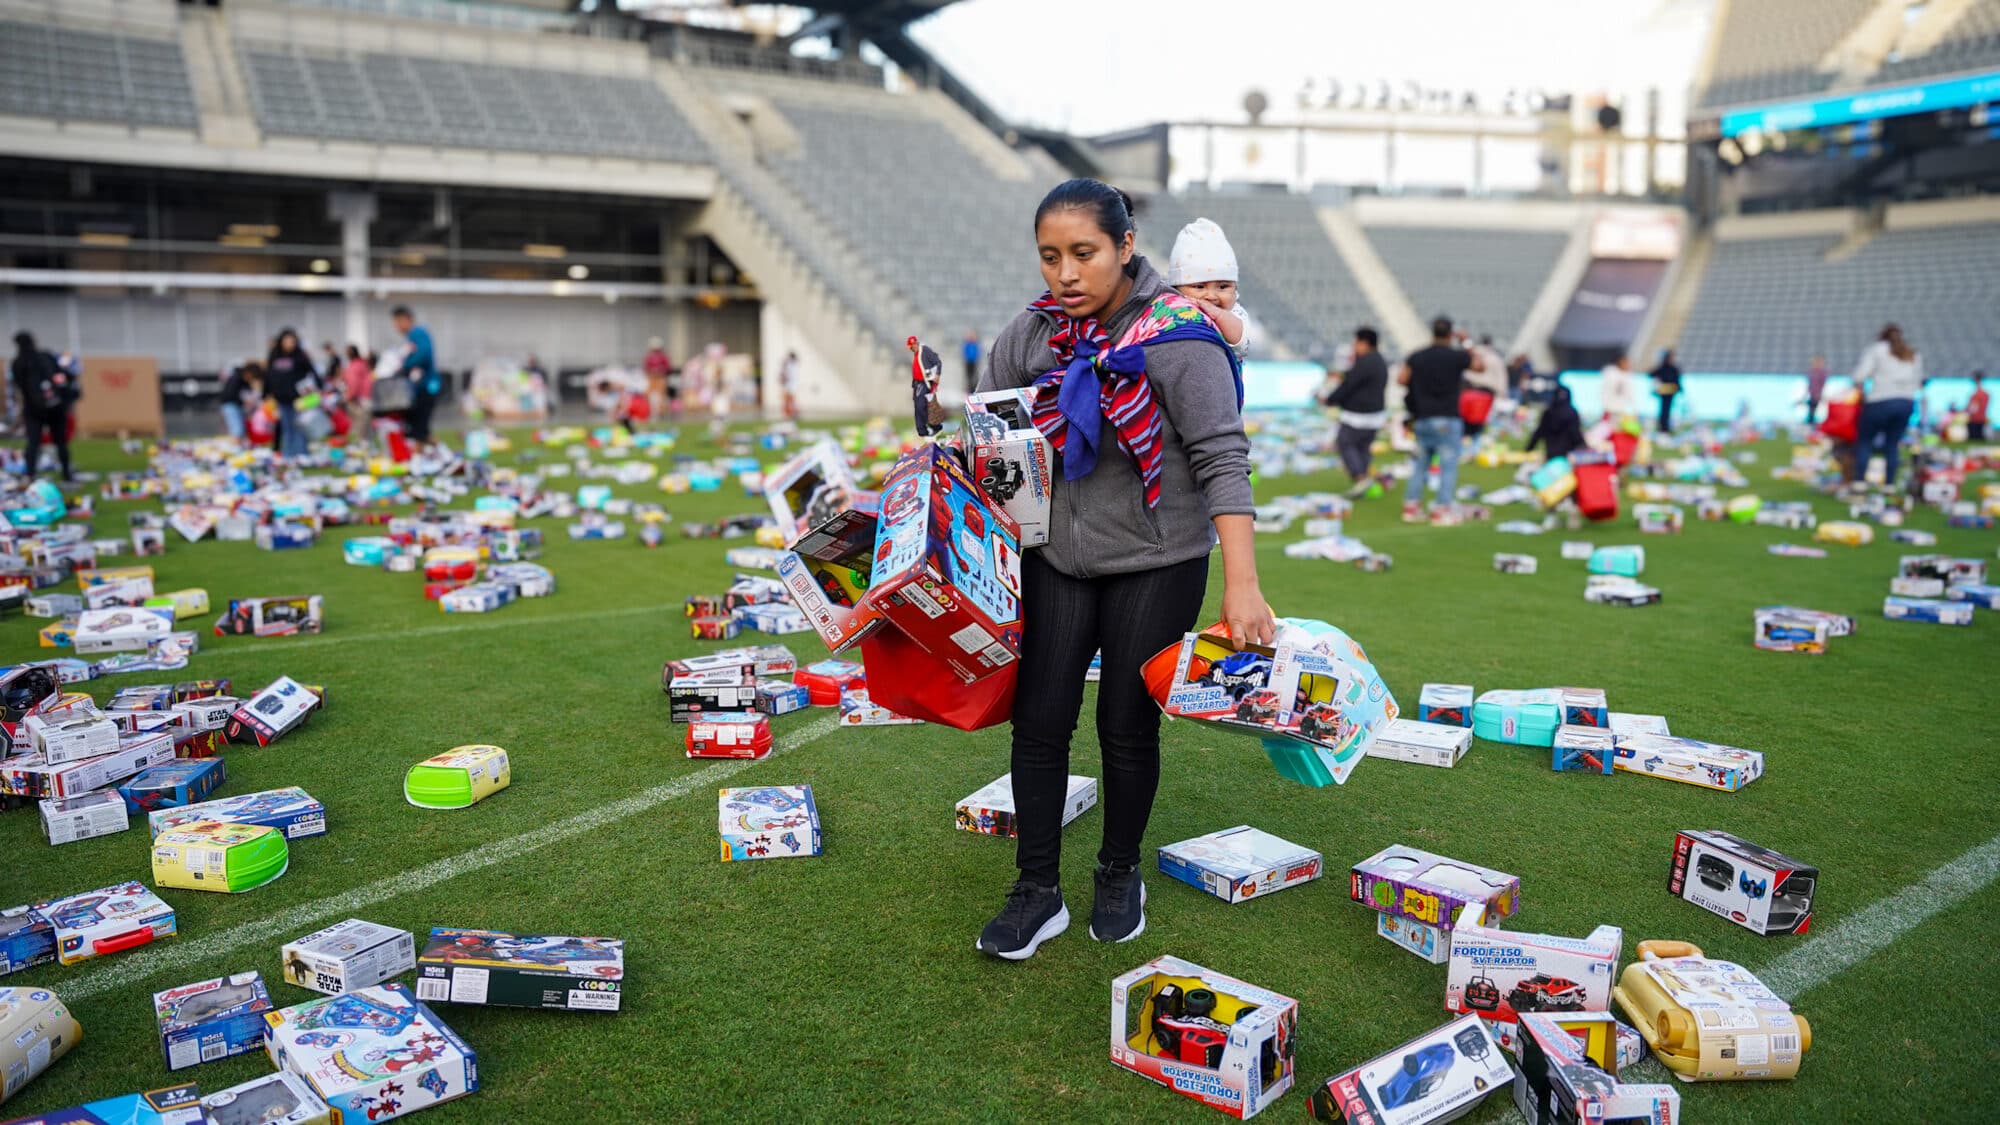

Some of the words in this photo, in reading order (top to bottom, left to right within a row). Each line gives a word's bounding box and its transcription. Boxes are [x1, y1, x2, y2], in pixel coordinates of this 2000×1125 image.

[1169, 694, 1194, 704] FORD
[1195, 690, 1221, 700] F-150
[1197, 700, 1230, 709] RAPTOR
[208, 709, 228, 717] STAR
[1691, 894, 1705, 905] DIVO
[1705, 902, 1730, 916] BUGATTI
[1453, 947, 1486, 957] FORD
[1489, 948, 1521, 957] F-150
[1473, 957, 1493, 966] SVT
[1494, 957, 1536, 966] RAPTOR
[316, 973, 342, 985] WARS
[316, 980, 343, 993] STAR
[585, 992, 616, 1001] WARNING:
[1162, 1065, 1201, 1081] RAPTOR
[1174, 1077, 1207, 1093] F-150
[1202, 1074, 1221, 1085] SVT
[166, 1089, 187, 1100] 17
[1208, 1084, 1241, 1100] FORD
